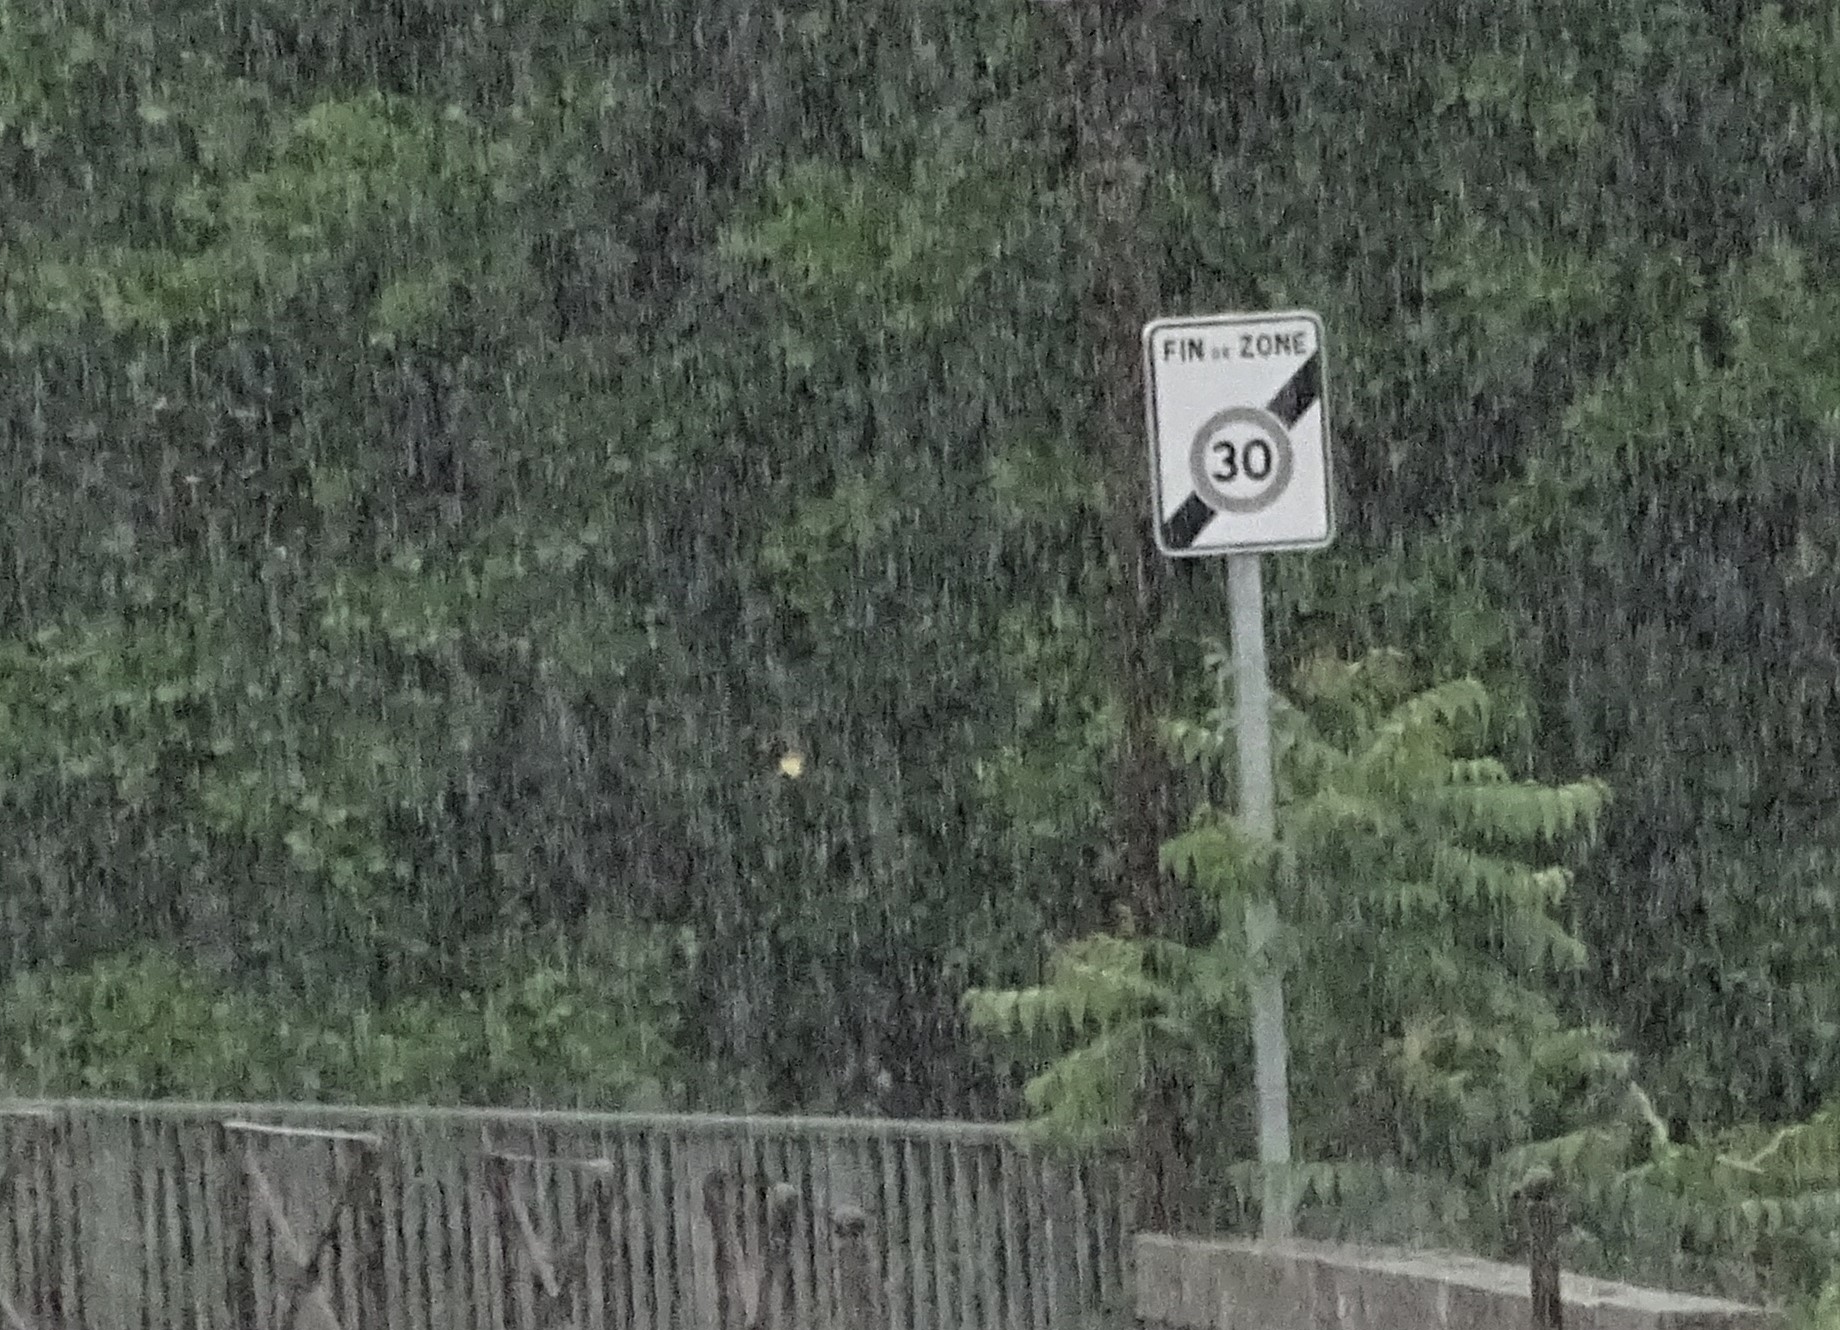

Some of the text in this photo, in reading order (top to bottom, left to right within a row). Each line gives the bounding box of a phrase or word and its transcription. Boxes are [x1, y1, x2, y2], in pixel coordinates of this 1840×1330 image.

[1163, 338, 1205, 363] FIN
[1239, 331, 1307, 360] ZONE
[1212, 438, 1273, 483] 30
